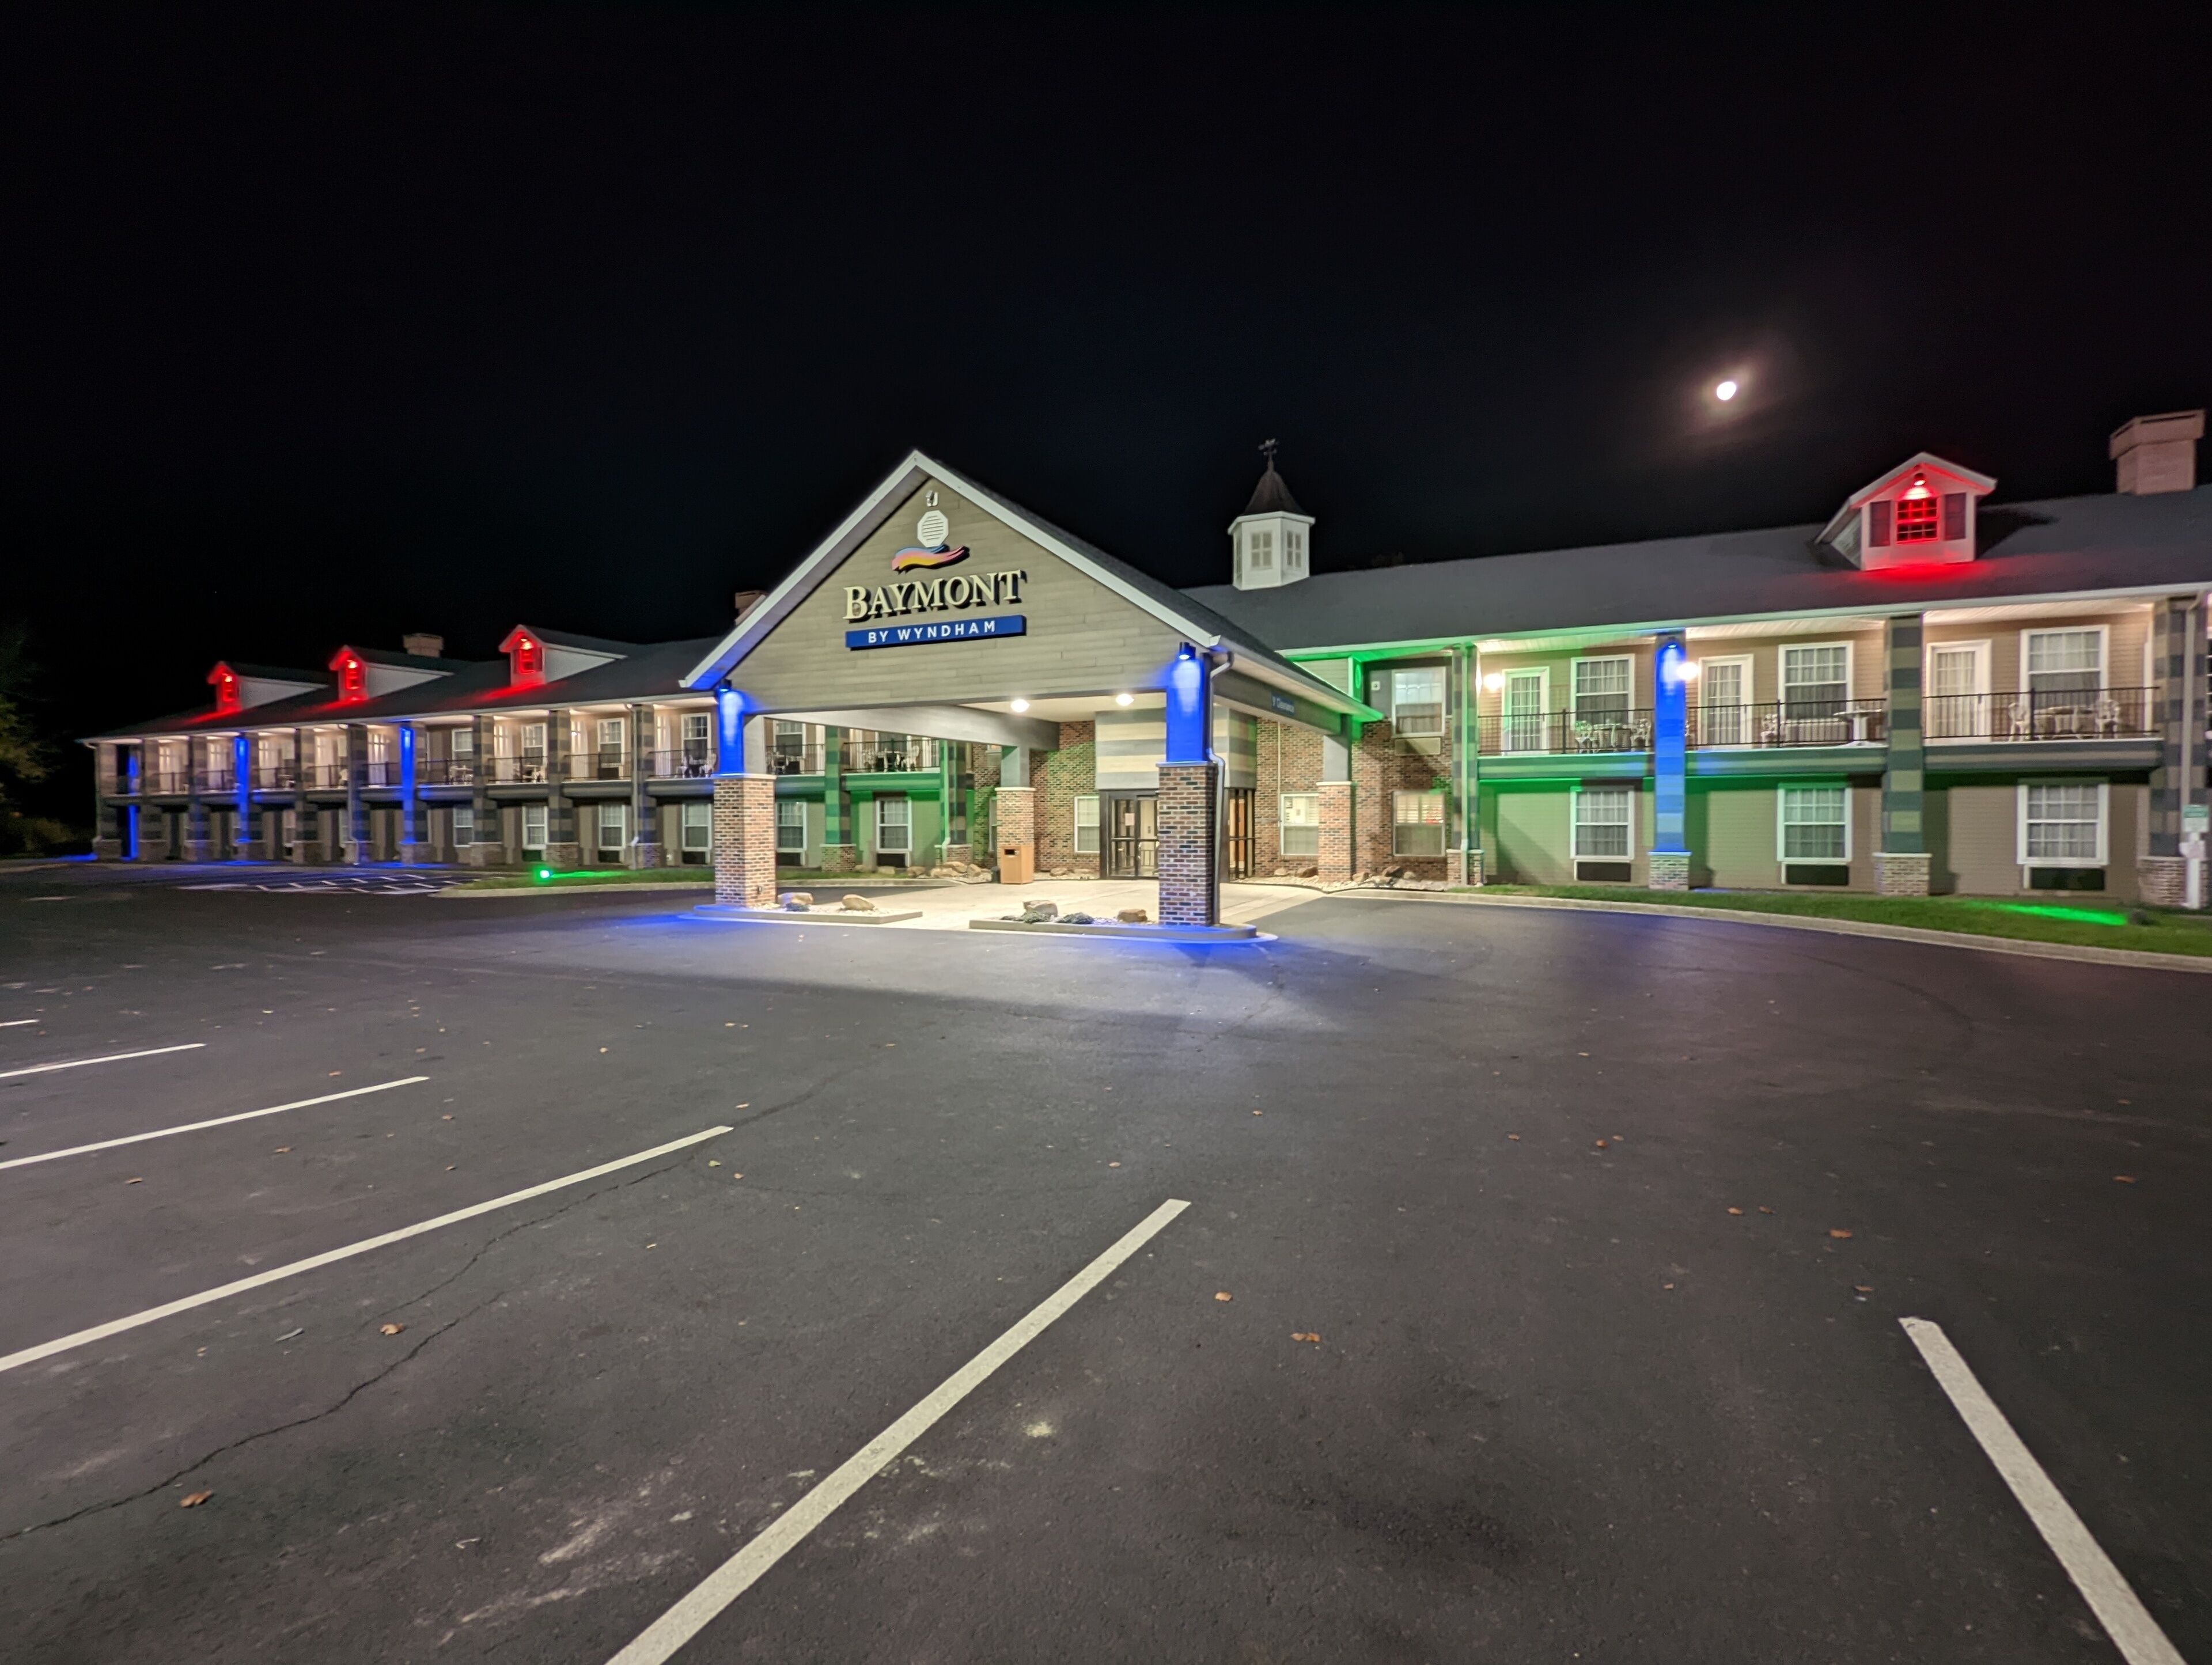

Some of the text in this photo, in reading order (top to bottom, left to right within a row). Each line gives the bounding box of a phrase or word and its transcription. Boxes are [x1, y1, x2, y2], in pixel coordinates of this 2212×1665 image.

[843, 569, 1022, 620] BAYMONT
[868, 620, 996, 643] BY WYNDHAM
